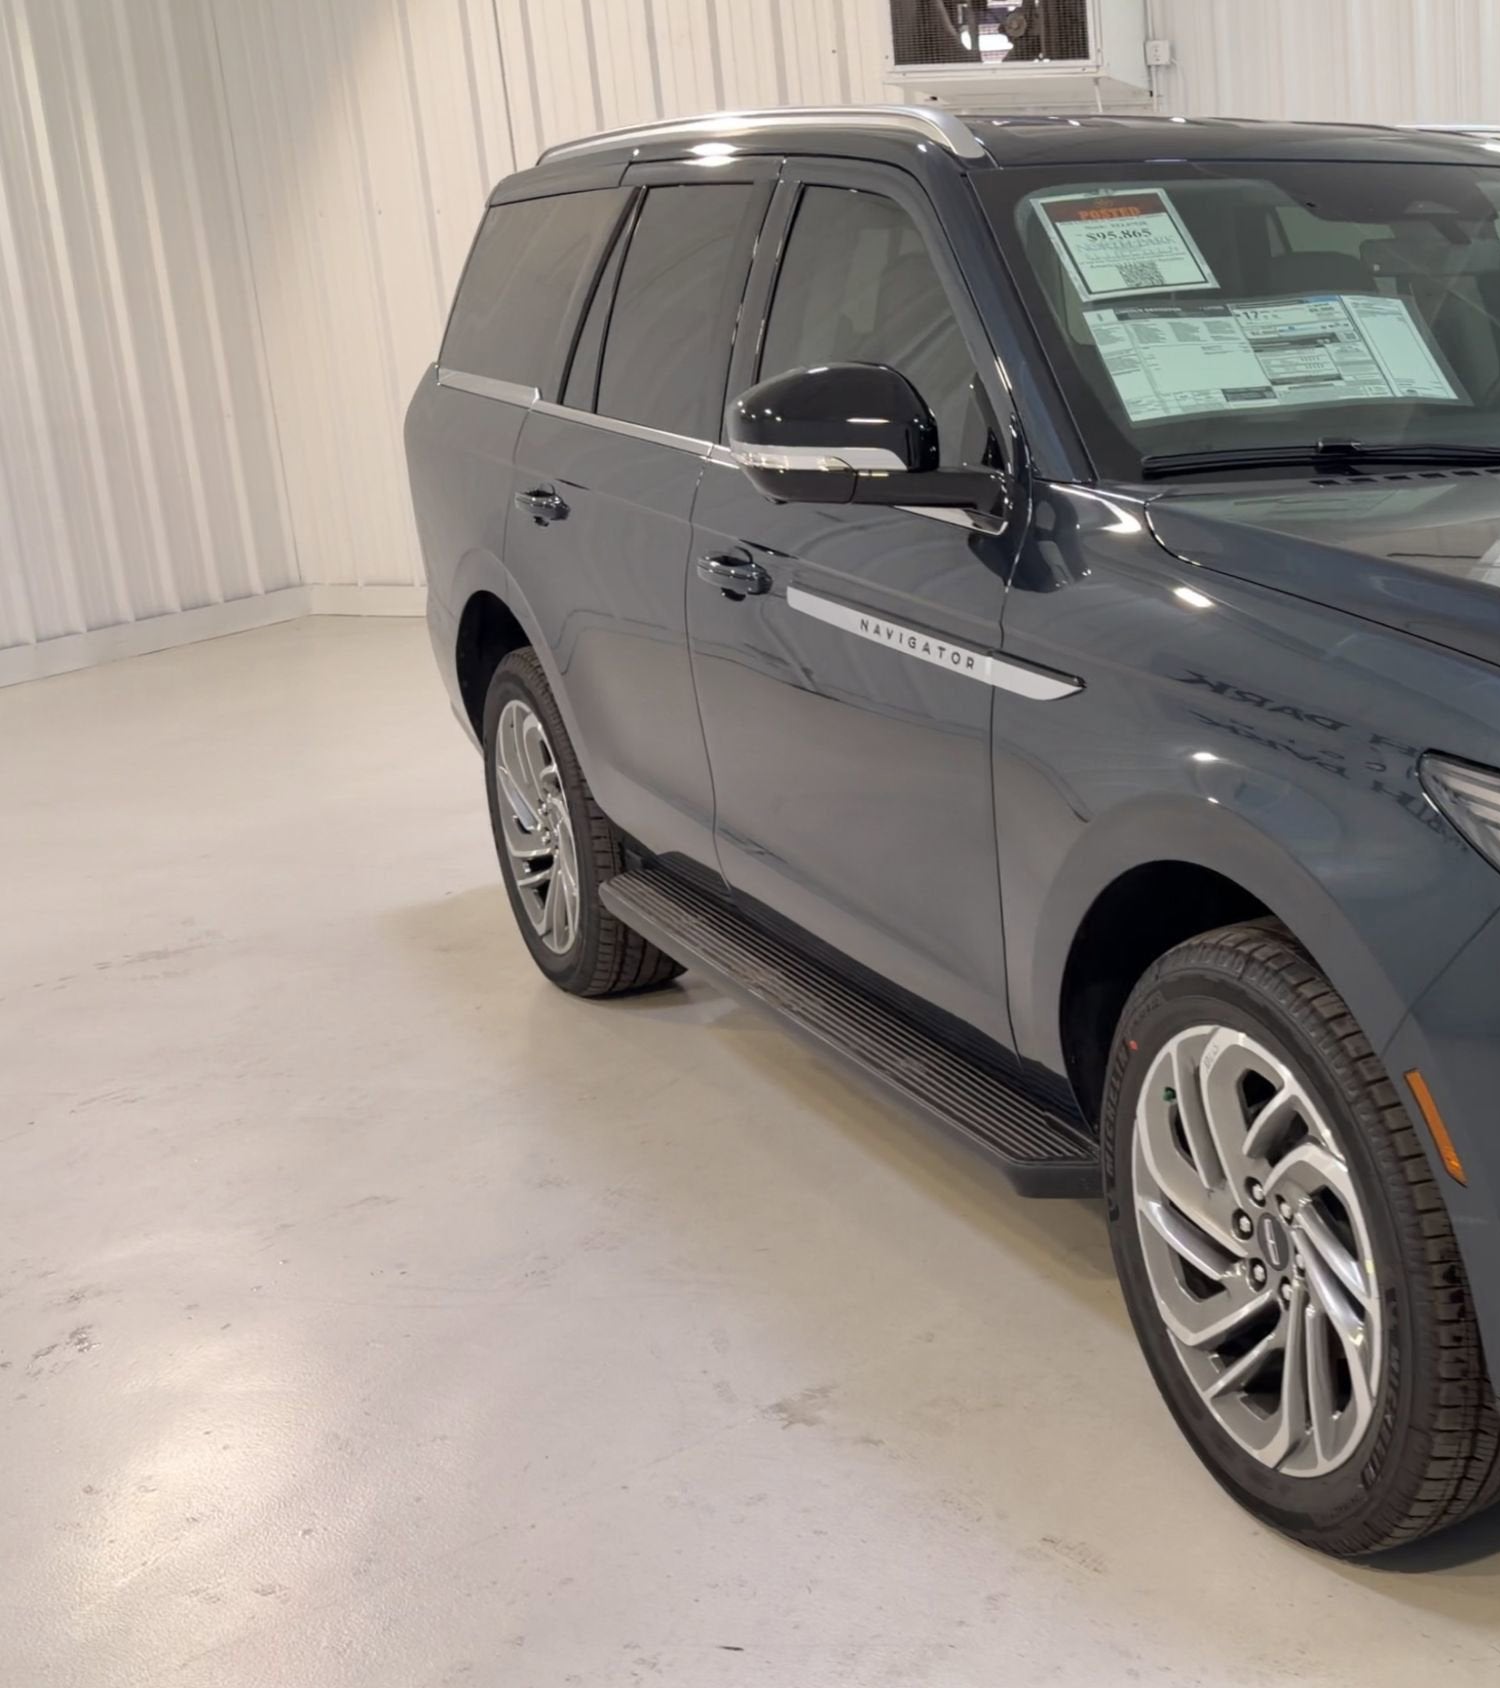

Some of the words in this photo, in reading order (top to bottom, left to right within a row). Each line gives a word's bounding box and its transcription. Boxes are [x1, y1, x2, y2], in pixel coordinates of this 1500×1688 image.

[1078, 206, 1141, 220] POSTED
[859, 618, 975, 671] NAVIGATOR
[1104, 1039, 1130, 1177] MICHELIN
